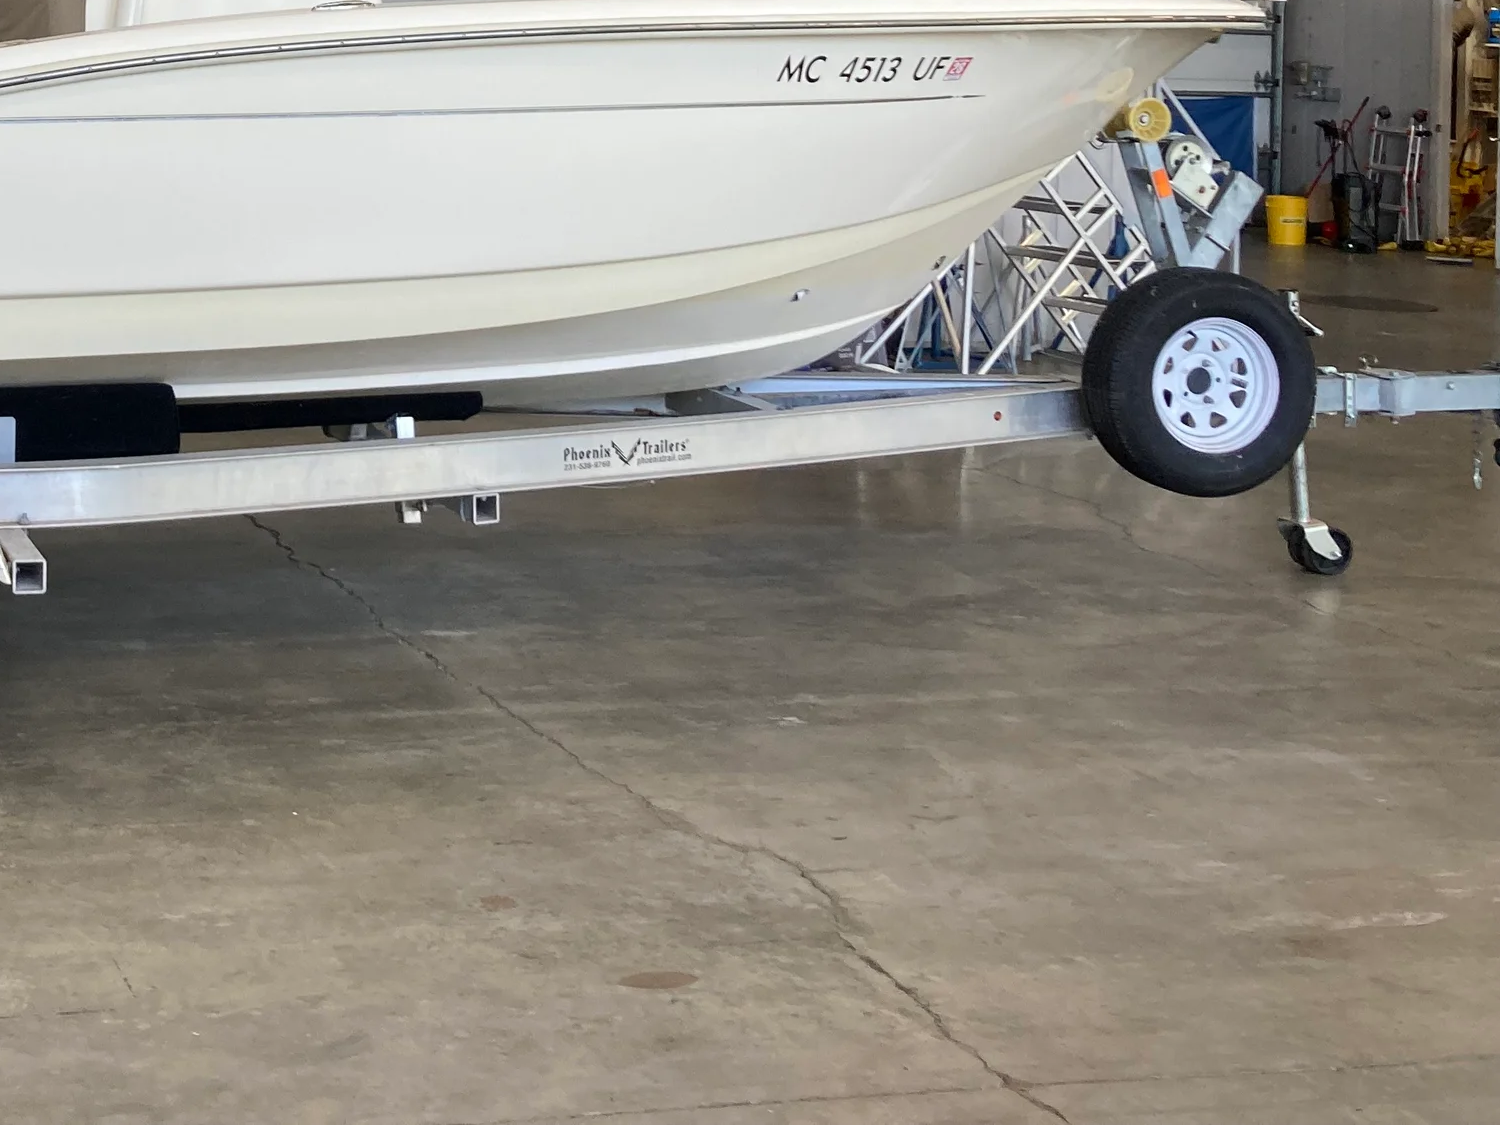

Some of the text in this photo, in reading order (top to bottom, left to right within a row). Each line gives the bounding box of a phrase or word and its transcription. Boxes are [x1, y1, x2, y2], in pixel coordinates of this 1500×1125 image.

[777, 55, 951, 83] MC 4513 UF
[563, 444, 611, 462] Phoenix
